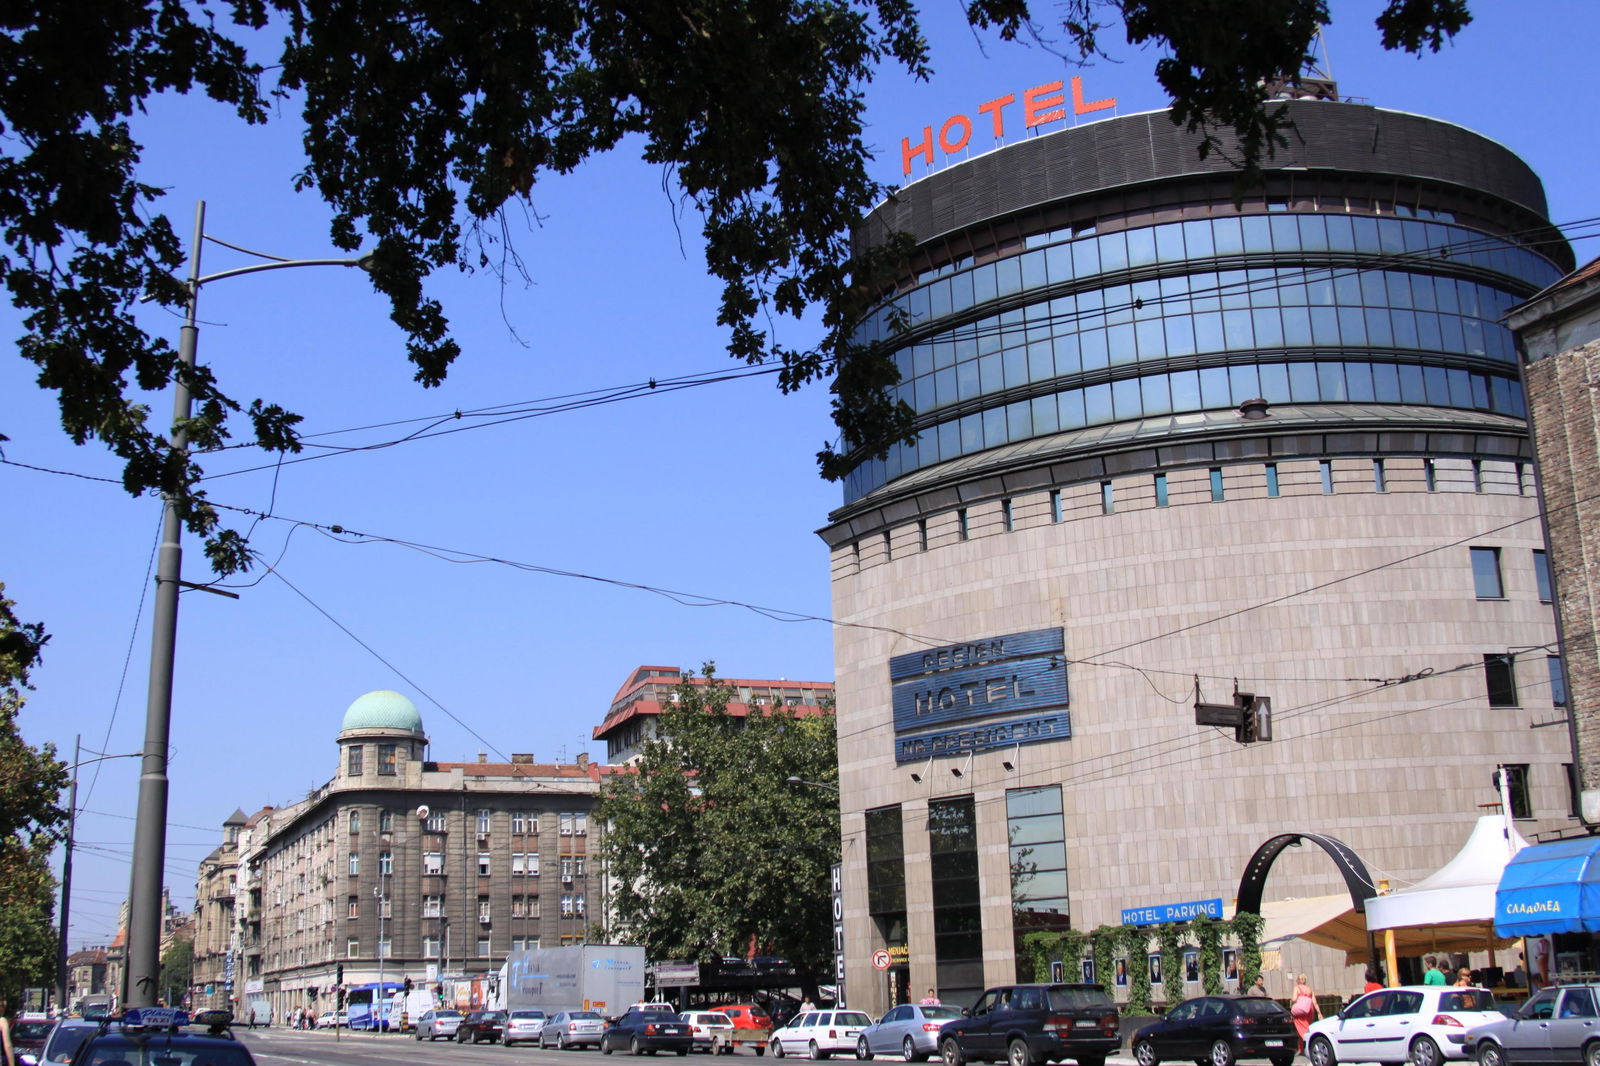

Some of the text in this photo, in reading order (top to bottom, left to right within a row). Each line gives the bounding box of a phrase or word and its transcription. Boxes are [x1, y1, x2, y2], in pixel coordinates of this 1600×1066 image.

[901, 75, 1117, 176] HOTEL
[922, 640, 1005, 668] DESIGN
[914, 674, 1036, 716] HOTEL
[931, 718, 1058, 750] PRESIDENT
[1123, 902, 1216, 923] HOTEL PARKING
[832, 867, 846, 1009] HOTEL
[888, 943, 909, 956] MENJAČ
